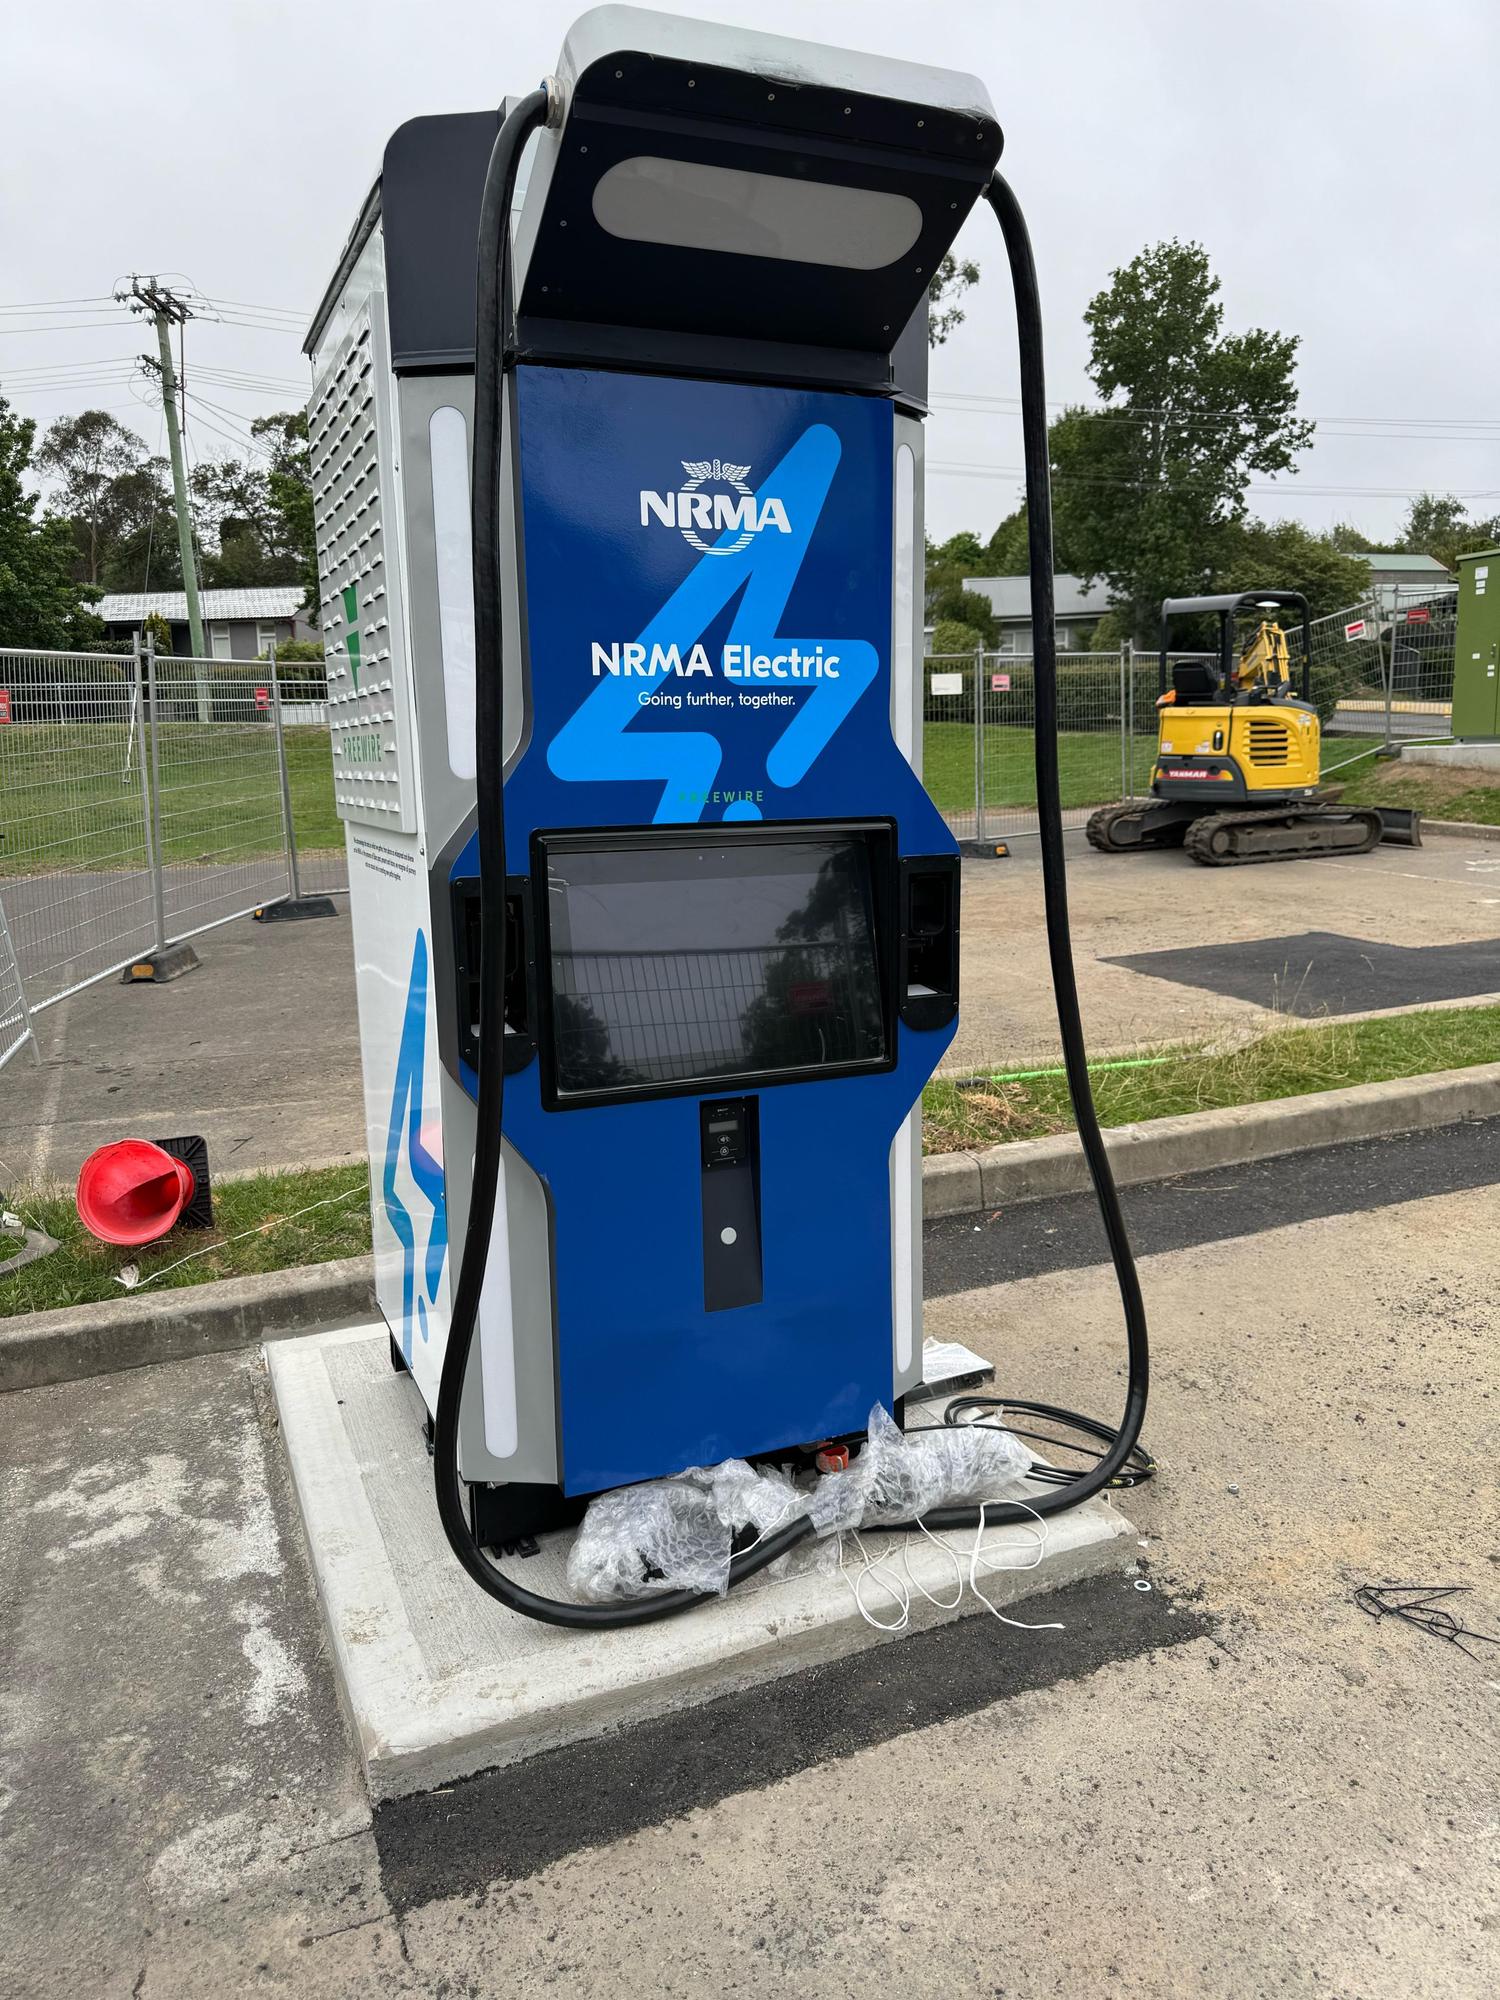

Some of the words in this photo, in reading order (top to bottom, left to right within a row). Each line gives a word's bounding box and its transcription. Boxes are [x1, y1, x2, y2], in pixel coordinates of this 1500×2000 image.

[640, 490, 792, 534] NRMA
[591, 642, 713, 677] NRMA
[722, 644, 840, 679] Electric
[638, 691, 682, 709] Going
[687, 691, 734, 708] further,
[739, 691, 796, 709] together.
